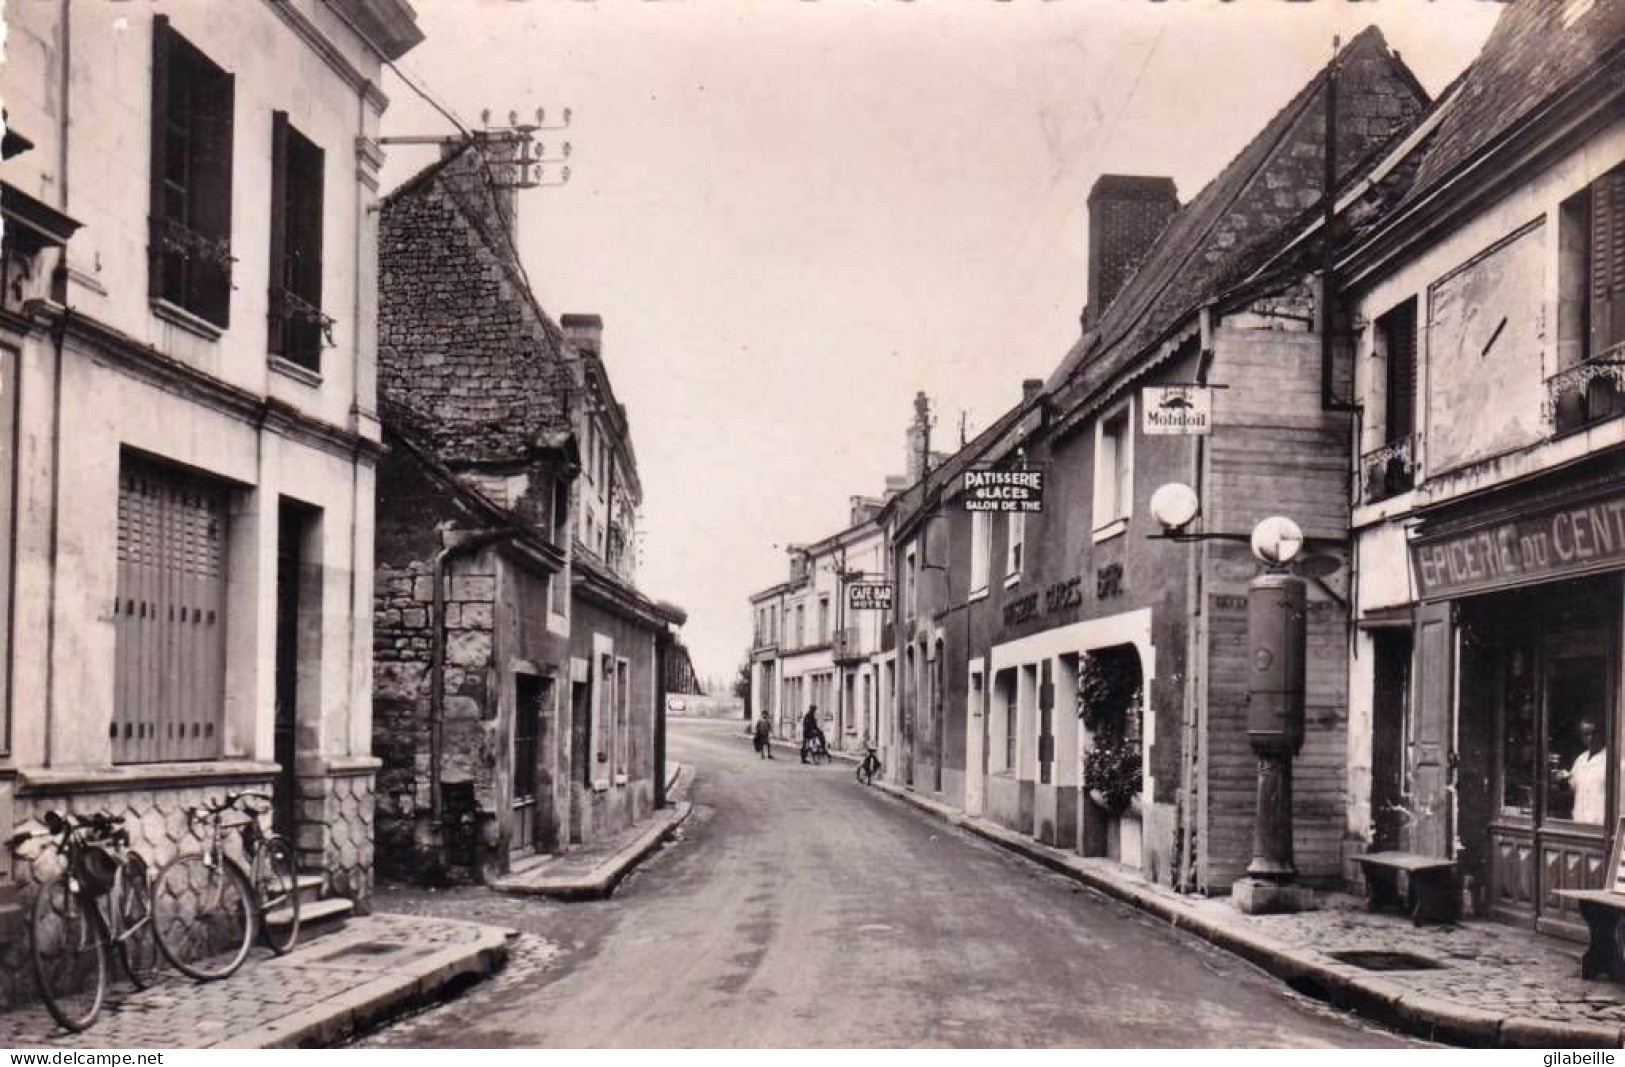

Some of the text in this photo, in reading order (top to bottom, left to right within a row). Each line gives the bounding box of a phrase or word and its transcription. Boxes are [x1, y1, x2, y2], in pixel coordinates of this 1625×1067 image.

[1147, 410, 1206, 426] Mobiloil
[964, 471, 1042, 490] PATISSERIE
[975, 486, 1029, 499] GLACES
[965, 500, 1042, 511] SALON DE THE
[1419, 525, 1519, 586] EPICERIE
[1520, 531, 1550, 567] DU
[873, 586, 891, 600] BAR
[852, 599, 890, 609] HOTEL
